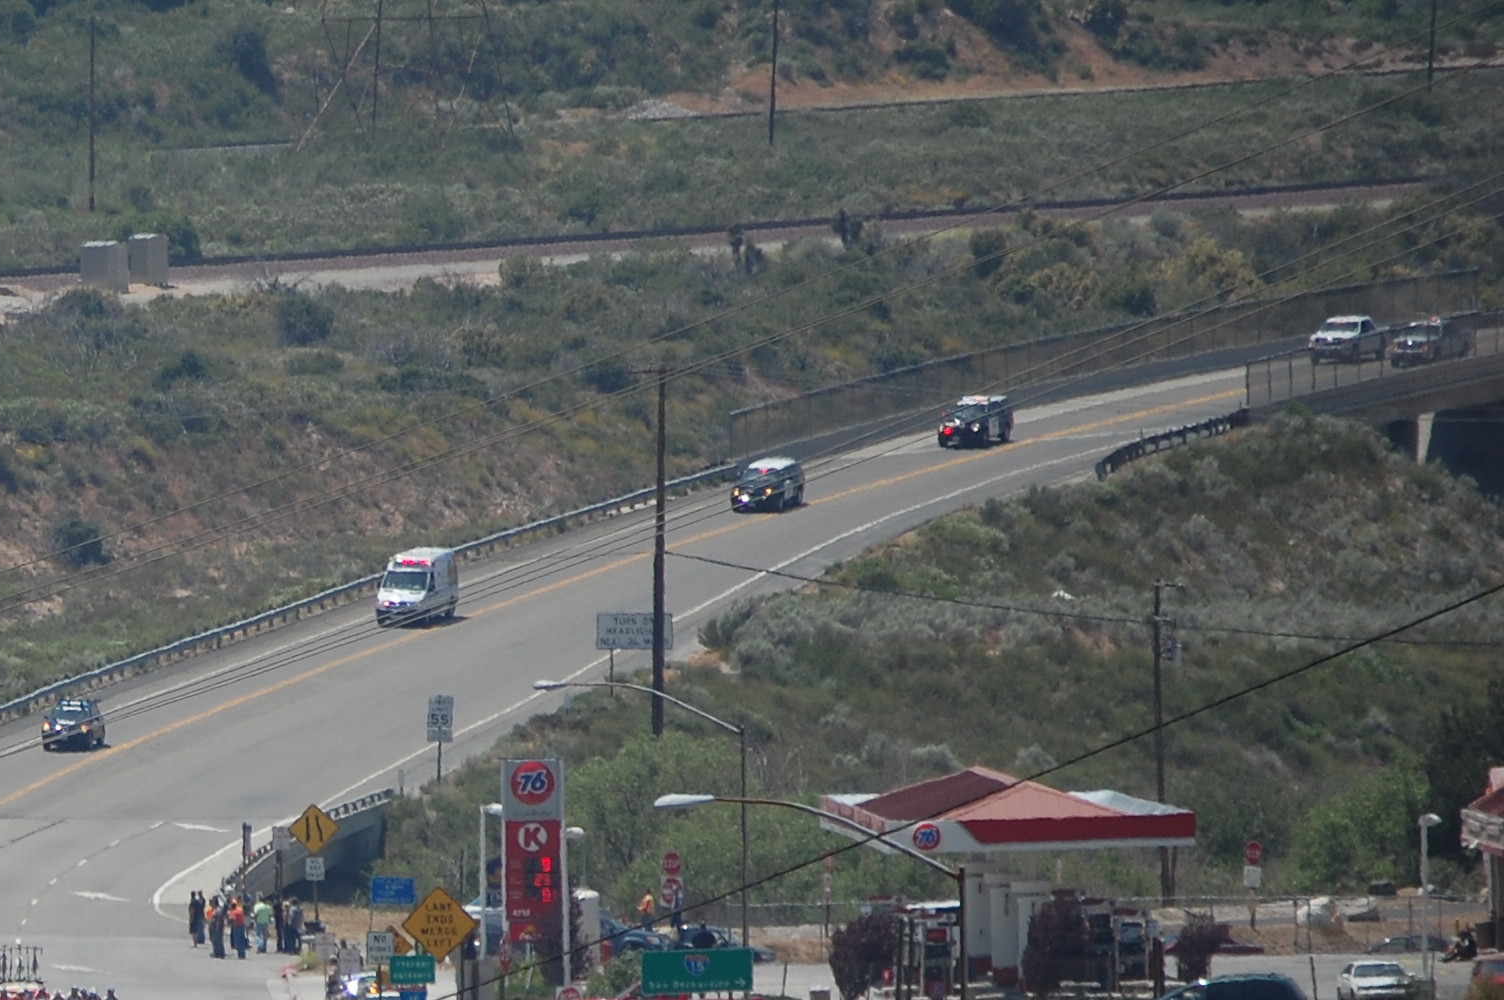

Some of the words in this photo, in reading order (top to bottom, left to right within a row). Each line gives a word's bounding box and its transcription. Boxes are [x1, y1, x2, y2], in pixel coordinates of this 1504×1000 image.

[431, 713, 449, 726] 55
[517, 770, 547, 795] 76
[522, 824, 547, 852] K
[917, 829, 937, 846] 76
[425, 903, 453, 912] LANE
[426, 915, 454, 924] ENDS
[421, 927, 458, 936] MERGE
[373, 935, 387, 944] NO
[690, 961, 705, 973] 15
